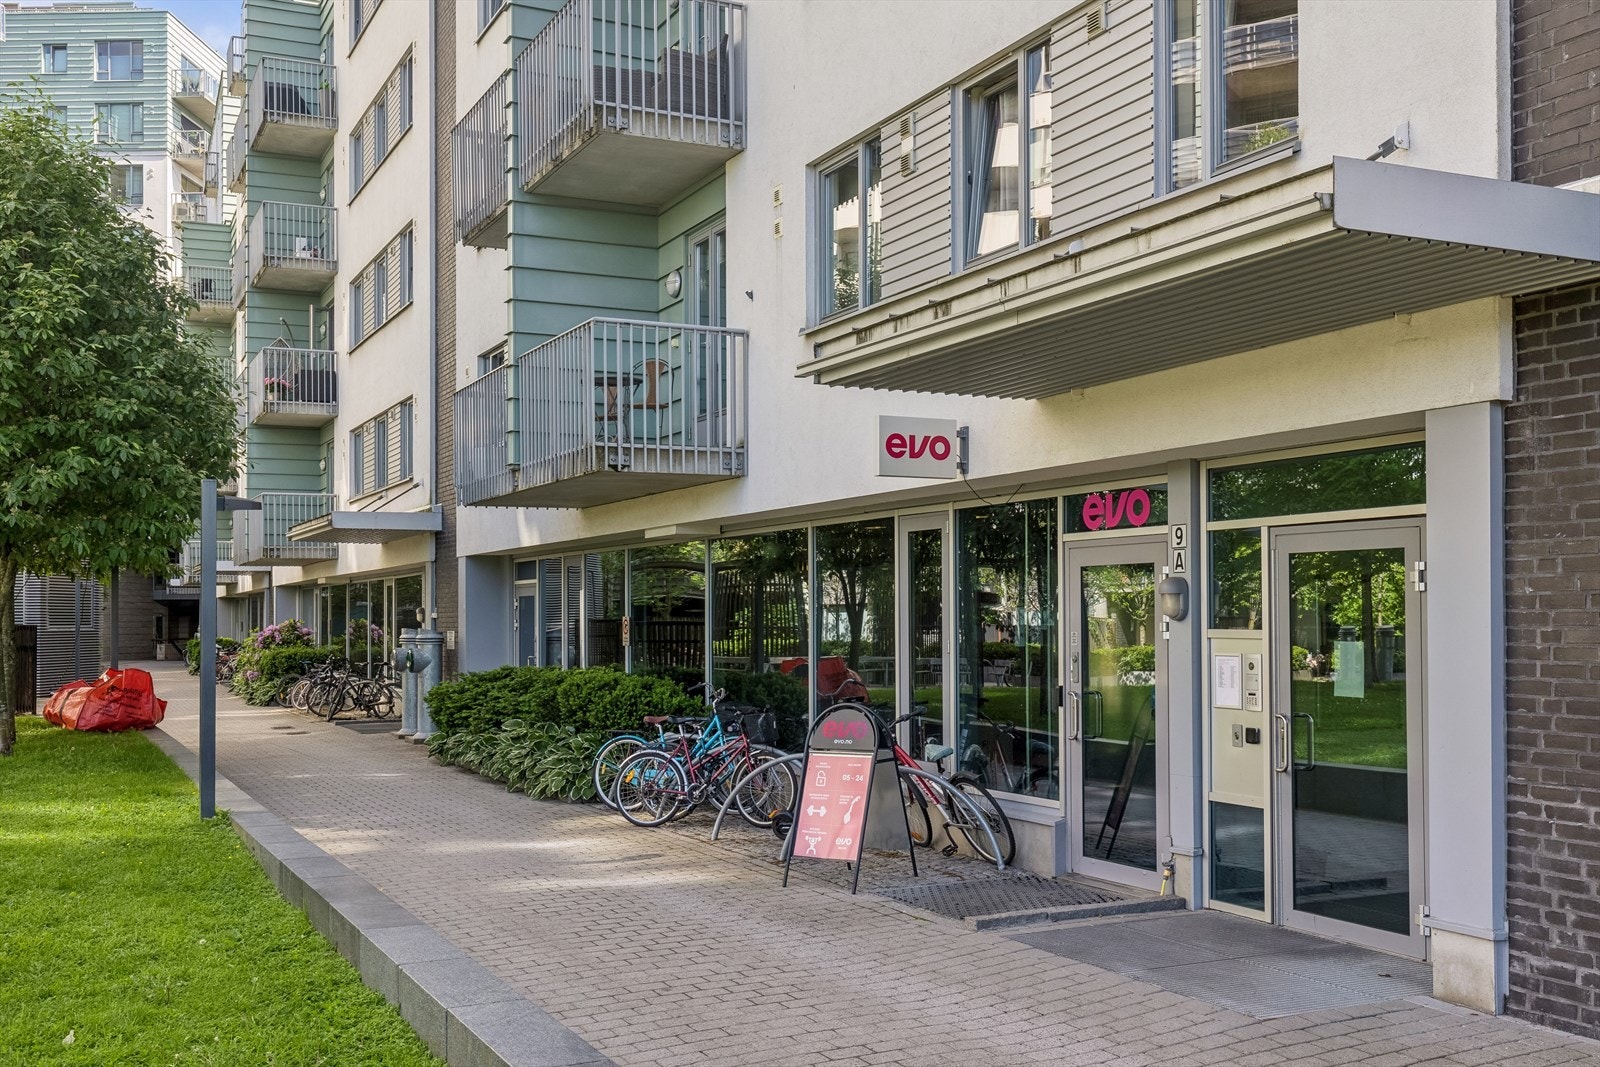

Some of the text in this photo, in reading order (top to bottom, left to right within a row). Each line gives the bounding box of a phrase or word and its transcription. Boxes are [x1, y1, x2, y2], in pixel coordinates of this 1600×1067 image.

[885, 432, 951, 461] evo
[1082, 488, 1151, 531] evo
[1175, 526, 1184, 546] 9
[1174, 552, 1184, 571] A
[822, 720, 868, 740] evo
[835, 837, 852, 846] evo
